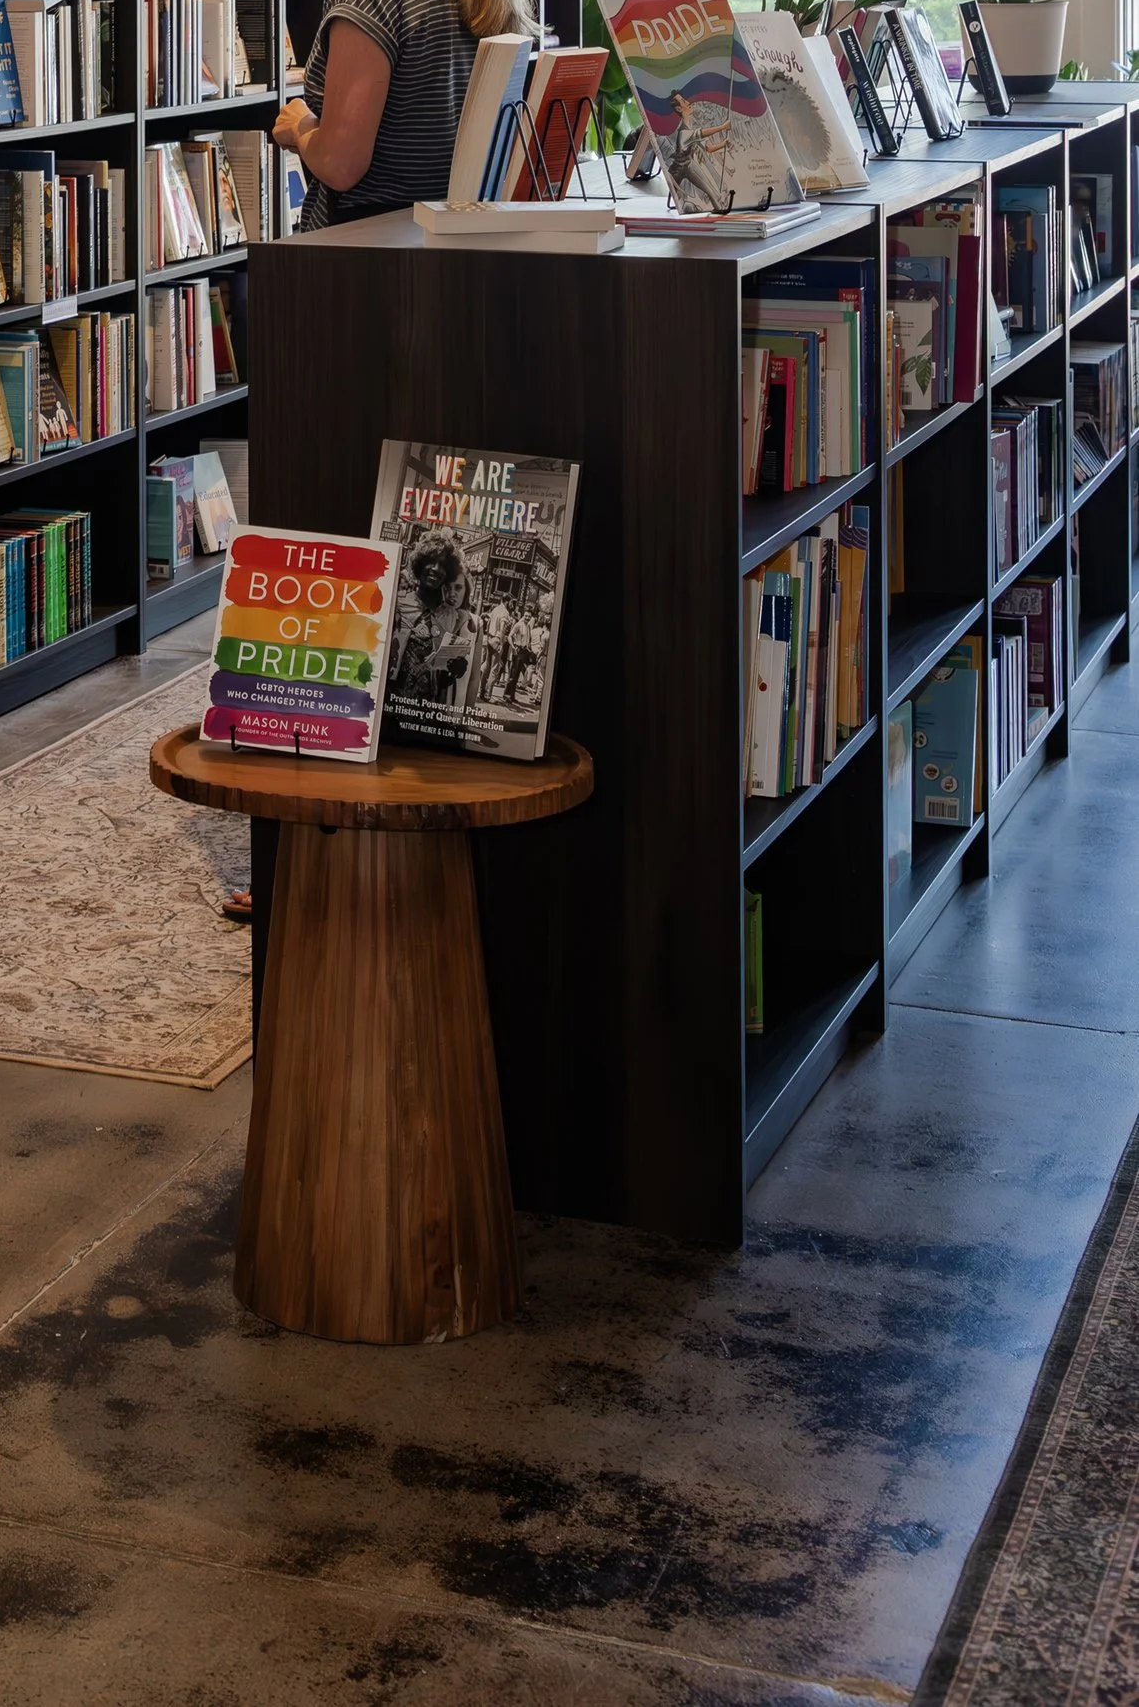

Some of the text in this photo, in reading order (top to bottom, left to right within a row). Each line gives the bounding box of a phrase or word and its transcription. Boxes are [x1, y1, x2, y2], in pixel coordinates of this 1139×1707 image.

[753, 39, 804, 73] Enough
[847, 34, 861, 63] applegate
[862, 80, 884, 127] wishtree
[435, 455, 517, 494] WE ARE
[198, 487, 229, 502] Educated
[399, 486, 541, 535] EVERYWHERE
[495, 537, 533, 551] VILLAGE
[495, 547, 528, 560] CIGARS
[283, 545, 337, 572] THE
[248, 571, 364, 613] BOOK
[279, 616, 321, 641] OF
[237, 642, 354, 683] PRIDE
[227, 690, 351, 714] WHO CHANGED THE WORLD
[256, 682, 324, 699] LGBTQ HEROES
[383, 703, 505, 732] he History of Queer Liberation
[389, 693, 498, 719] Protest, Power, and Pride in
[241, 715, 329, 737] MASON FUNK
